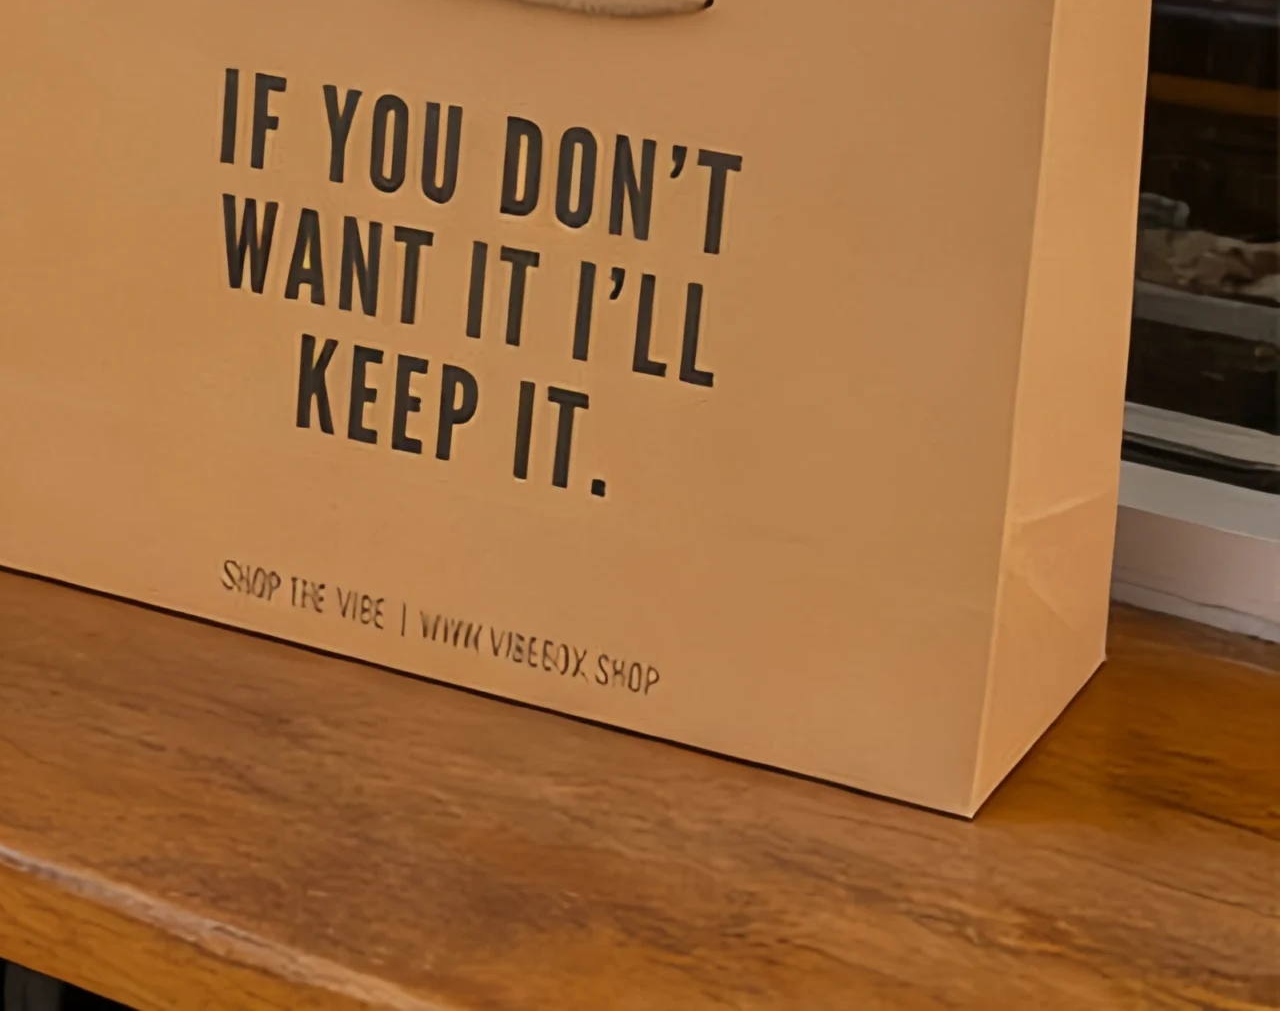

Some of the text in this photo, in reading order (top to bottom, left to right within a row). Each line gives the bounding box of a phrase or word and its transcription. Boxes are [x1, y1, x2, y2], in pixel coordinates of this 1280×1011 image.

[219, 68, 743, 255] IF YOU DON'T
[221, 192, 715, 388] WANT IT I'LL
[295, 333, 607, 498] KEEP IT.
[220, 559, 282, 602] SHOP
[336, 586, 385, 630] VIBE
